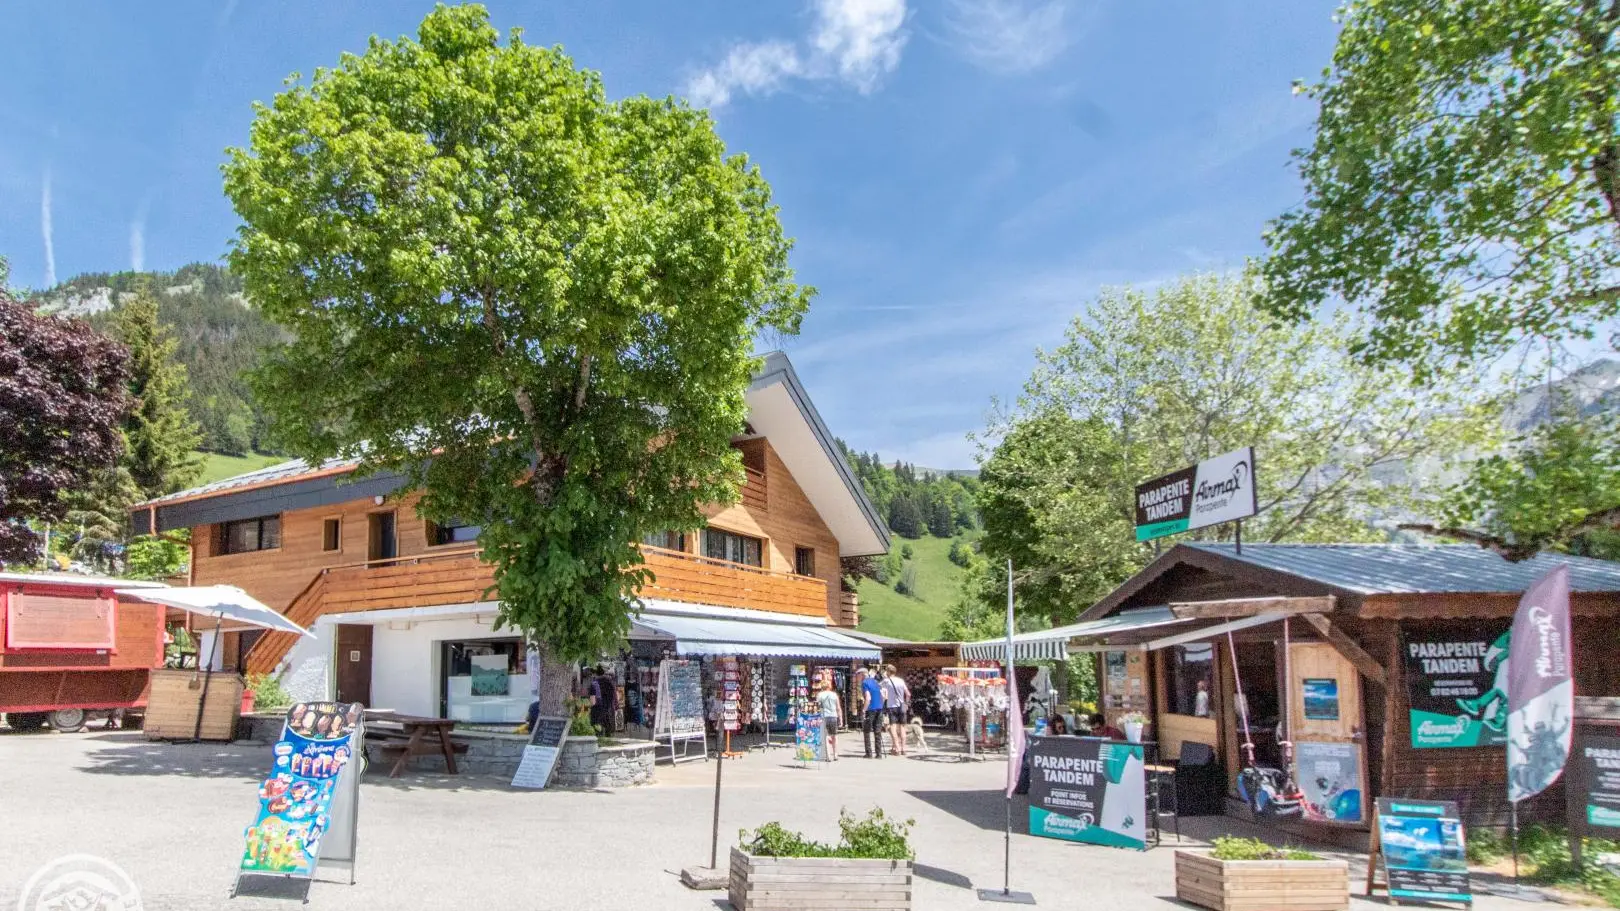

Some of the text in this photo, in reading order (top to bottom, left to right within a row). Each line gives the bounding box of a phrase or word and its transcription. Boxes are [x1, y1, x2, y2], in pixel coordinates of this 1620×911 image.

[1139, 479, 1190, 508] PARAPENTE
[1196, 474, 1240, 502] Airmax
[1146, 499, 1183, 521] TANDEM
[1409, 643, 1487, 657] PARAPENTE
[1422, 659, 1479, 673] TANDEM
[1034, 756, 1103, 773] PARAPENTE
[1043, 769, 1095, 786] TANDEM
[1050, 790, 1069, 799] POINT
